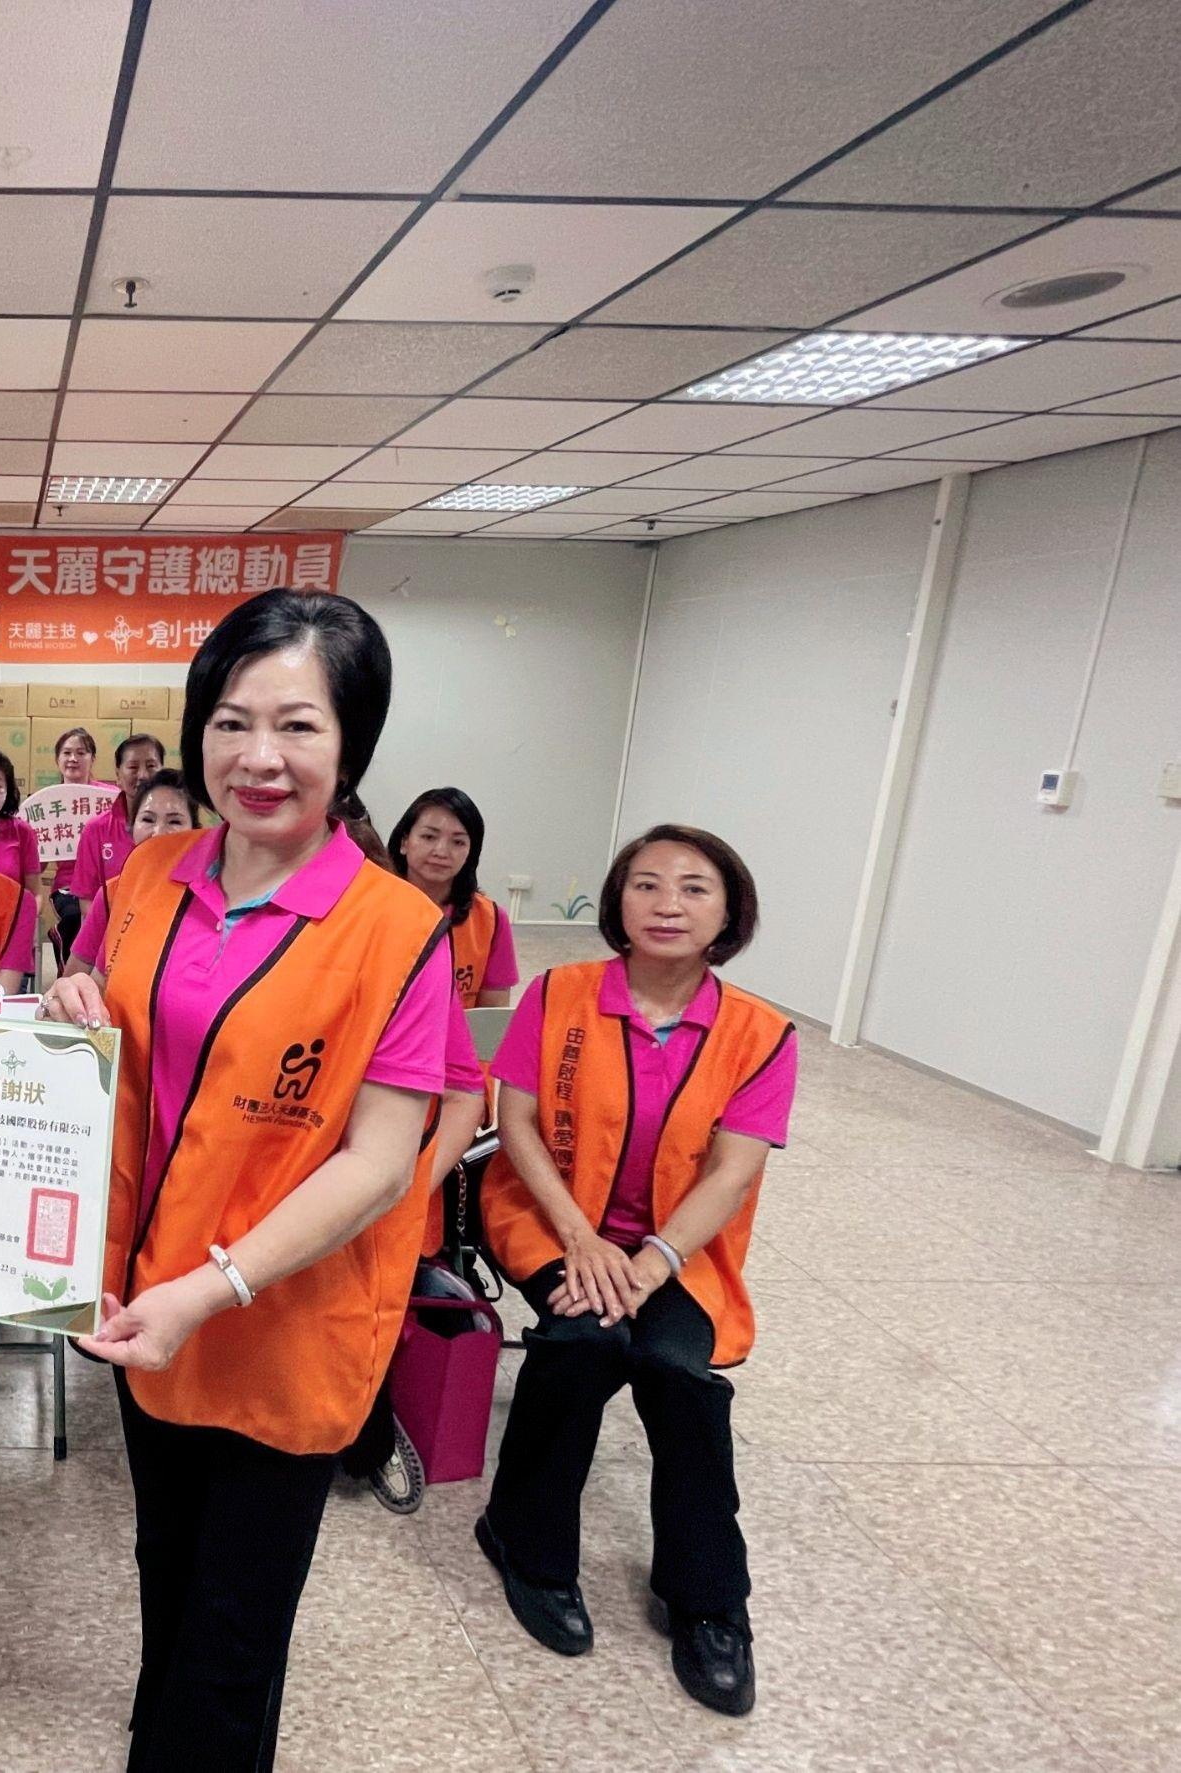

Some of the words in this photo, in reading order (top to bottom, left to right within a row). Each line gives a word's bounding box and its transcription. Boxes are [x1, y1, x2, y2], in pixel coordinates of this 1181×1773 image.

[8, 544, 333, 597] 天麗守護總動員
[8, 622, 77, 640] 天麗生技
[146, 619, 214, 649] 創世
